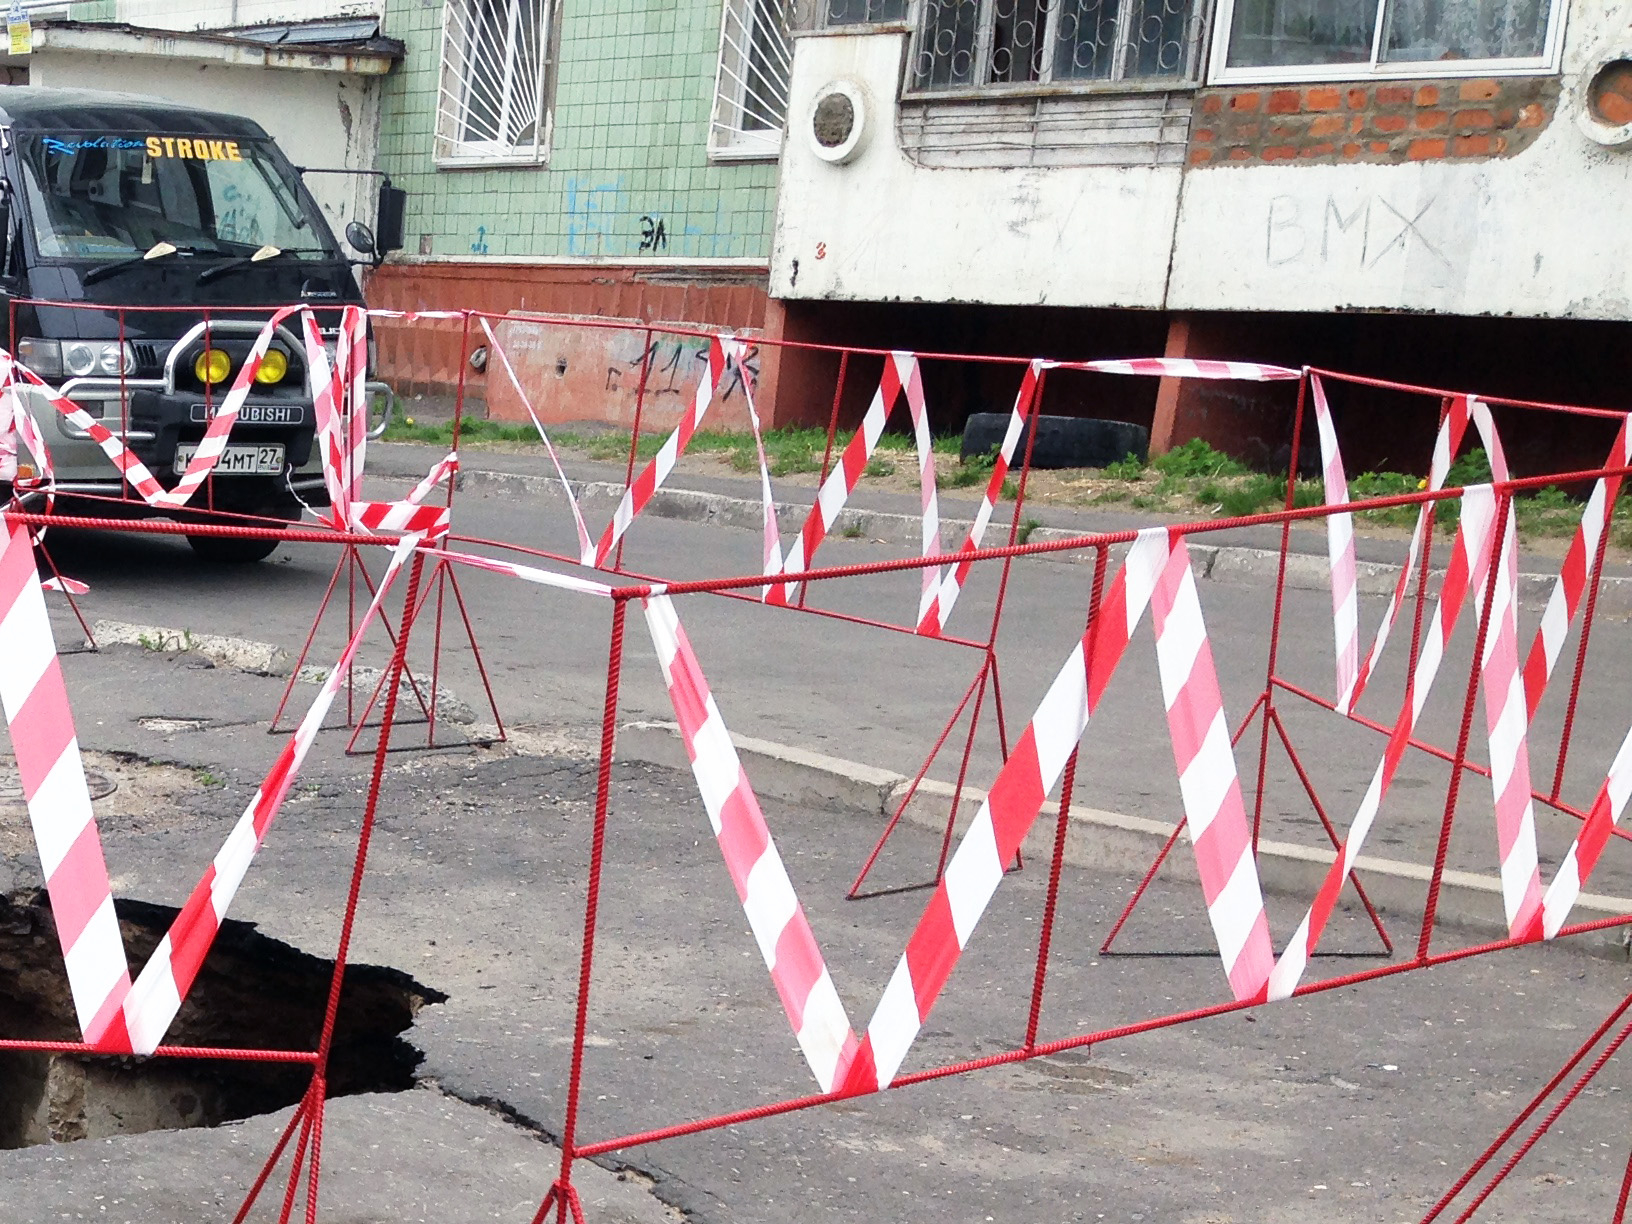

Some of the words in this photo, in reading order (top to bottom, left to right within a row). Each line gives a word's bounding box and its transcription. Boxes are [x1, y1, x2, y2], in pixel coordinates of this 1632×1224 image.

[146, 136, 242, 162] STROKE
[1266, 194, 1454, 272] BMX
[259, 449, 278, 464] 27
